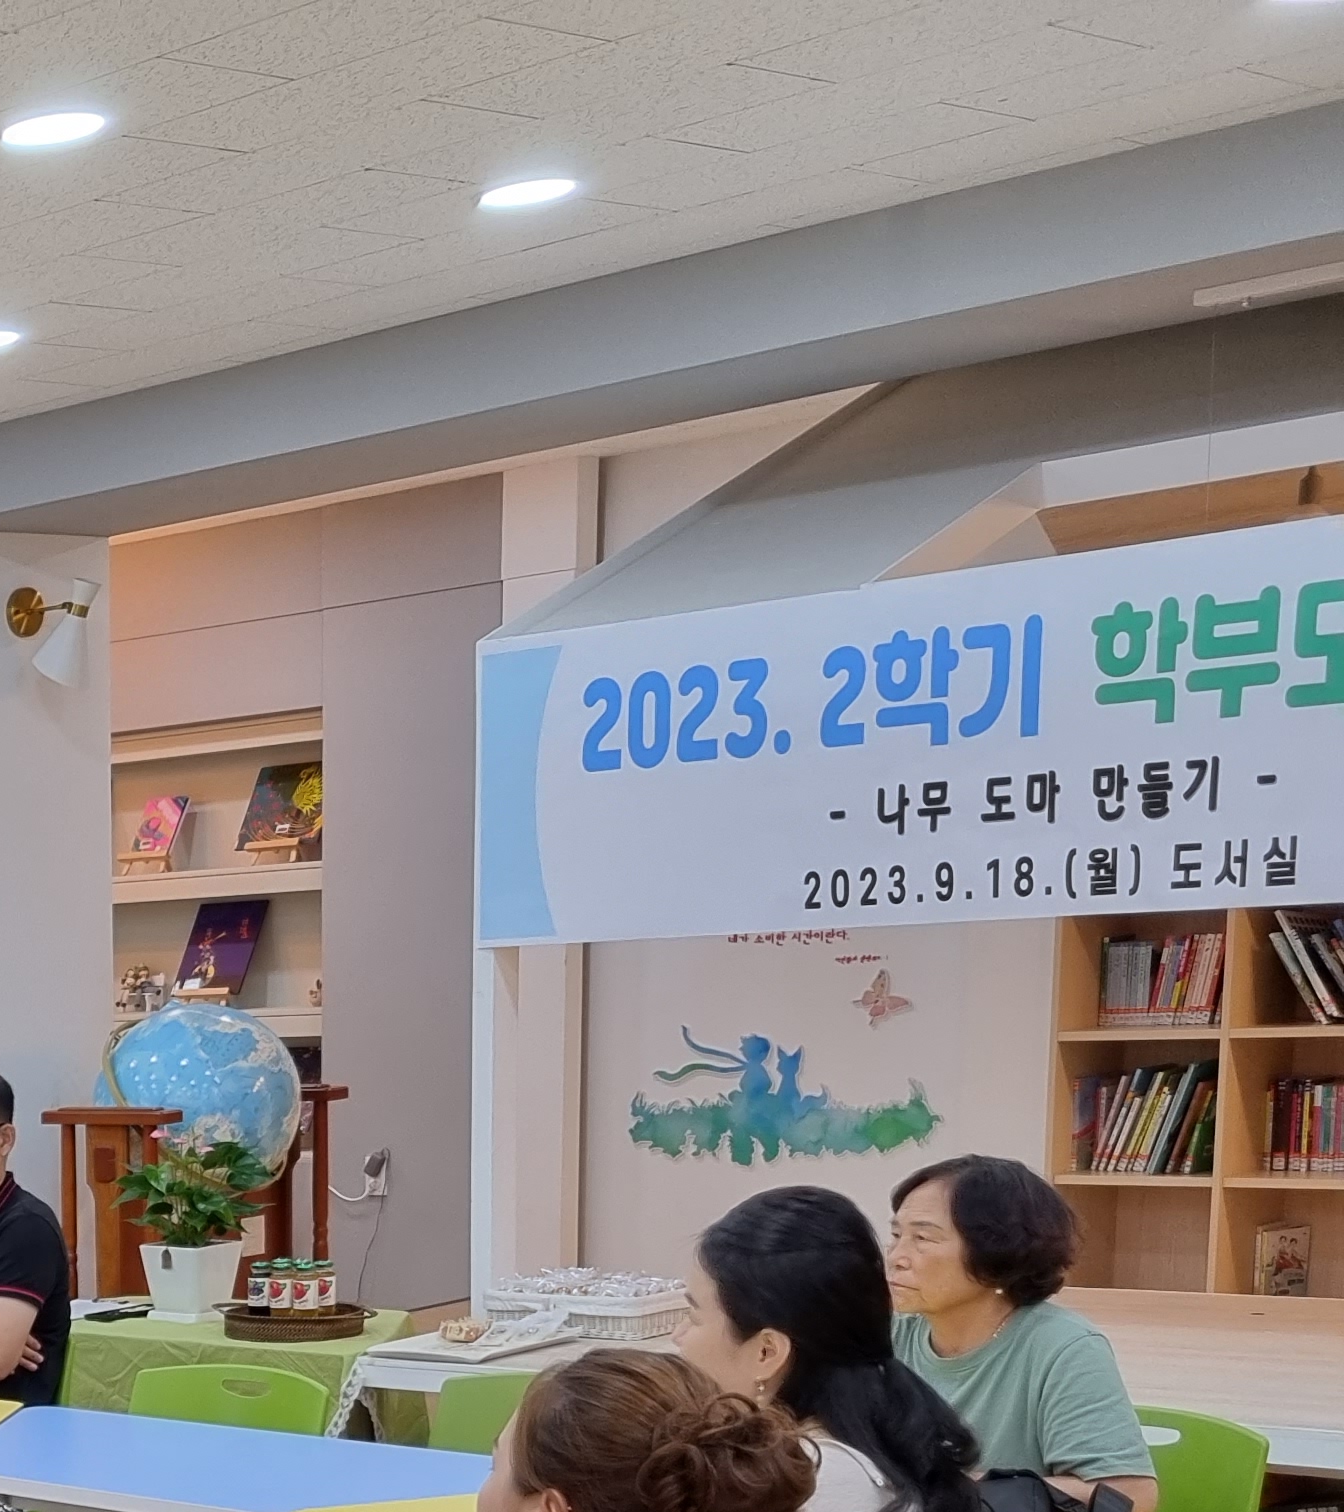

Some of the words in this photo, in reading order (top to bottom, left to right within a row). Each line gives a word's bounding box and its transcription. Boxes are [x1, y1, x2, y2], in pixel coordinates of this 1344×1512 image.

[581, 656, 793, 773] 2023.
[818, 612, 1045, 748] 2학기
[876, 779, 953, 836] 나무
[979, 770, 1061, 824] 도마
[1091, 755, 1221, 822] 만들기
[1169, 835, 1299, 890] 도서실
[727, 932, 750, 944] 네가
[753, 930, 787, 946] 소비한
